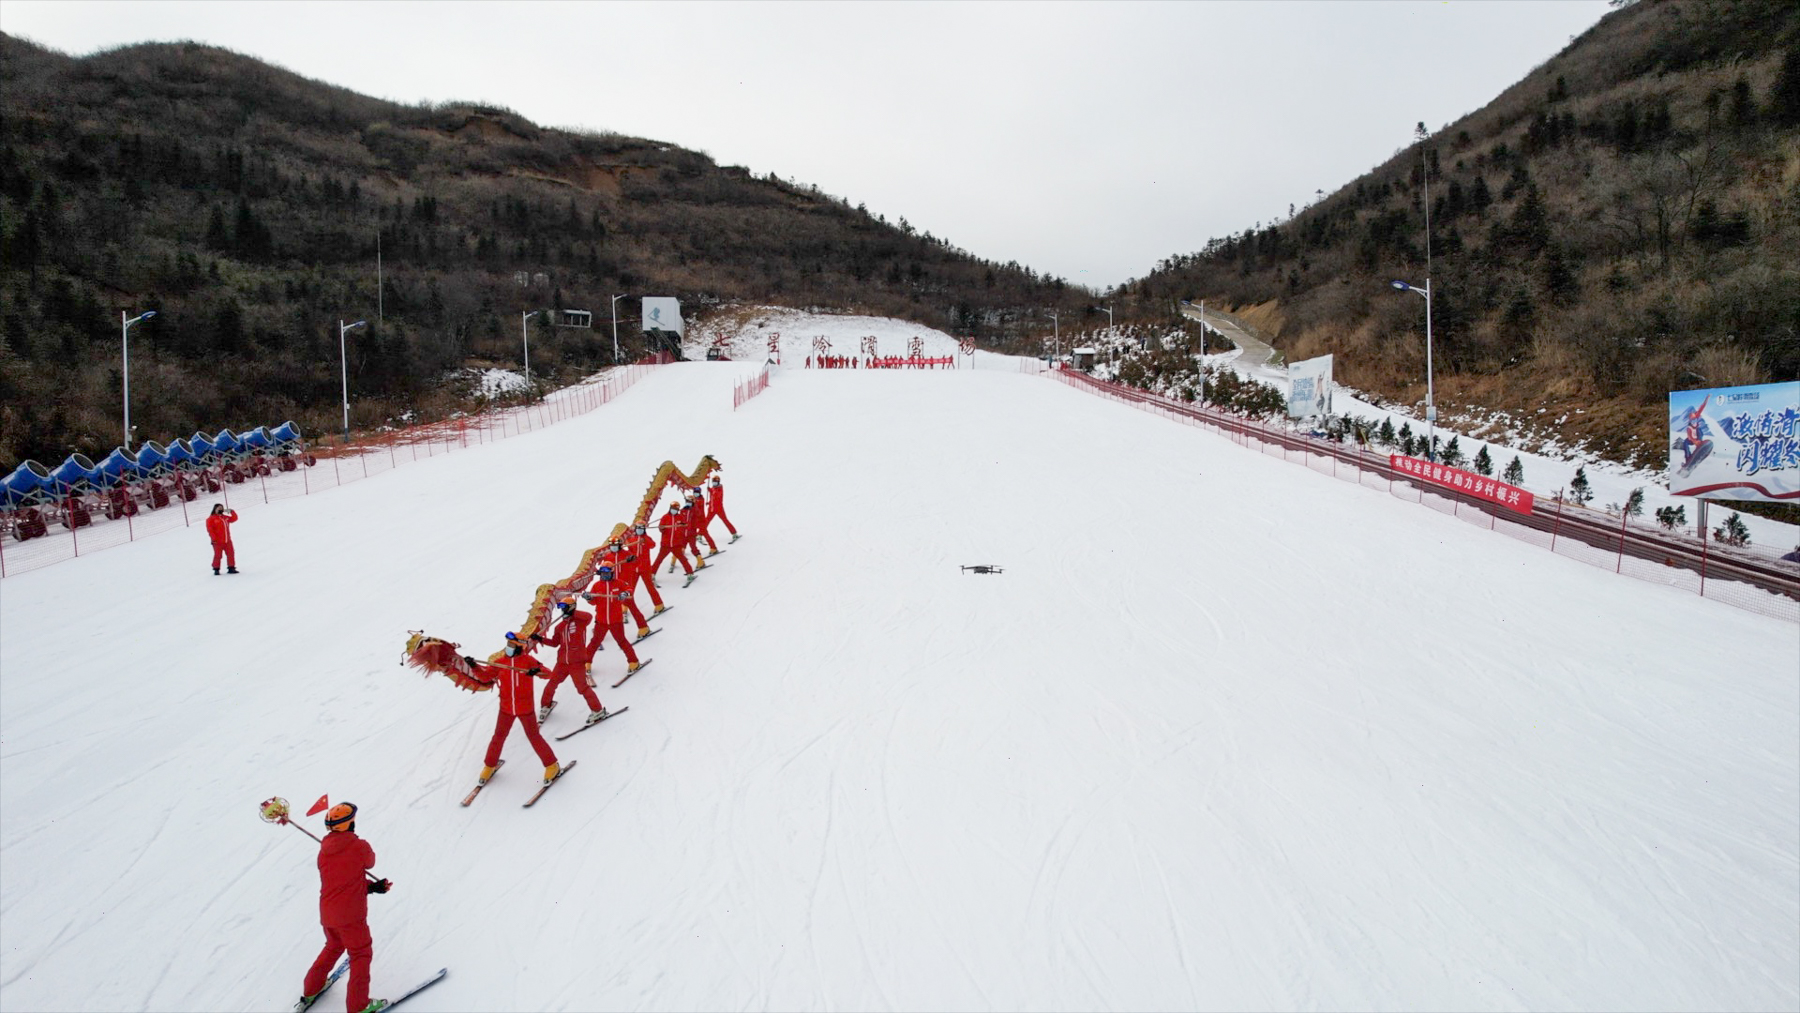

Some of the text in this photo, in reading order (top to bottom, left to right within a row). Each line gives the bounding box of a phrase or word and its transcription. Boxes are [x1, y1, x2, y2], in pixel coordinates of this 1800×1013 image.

[1395, 457, 1520, 505] 推动全民健身助力乡村振兴
